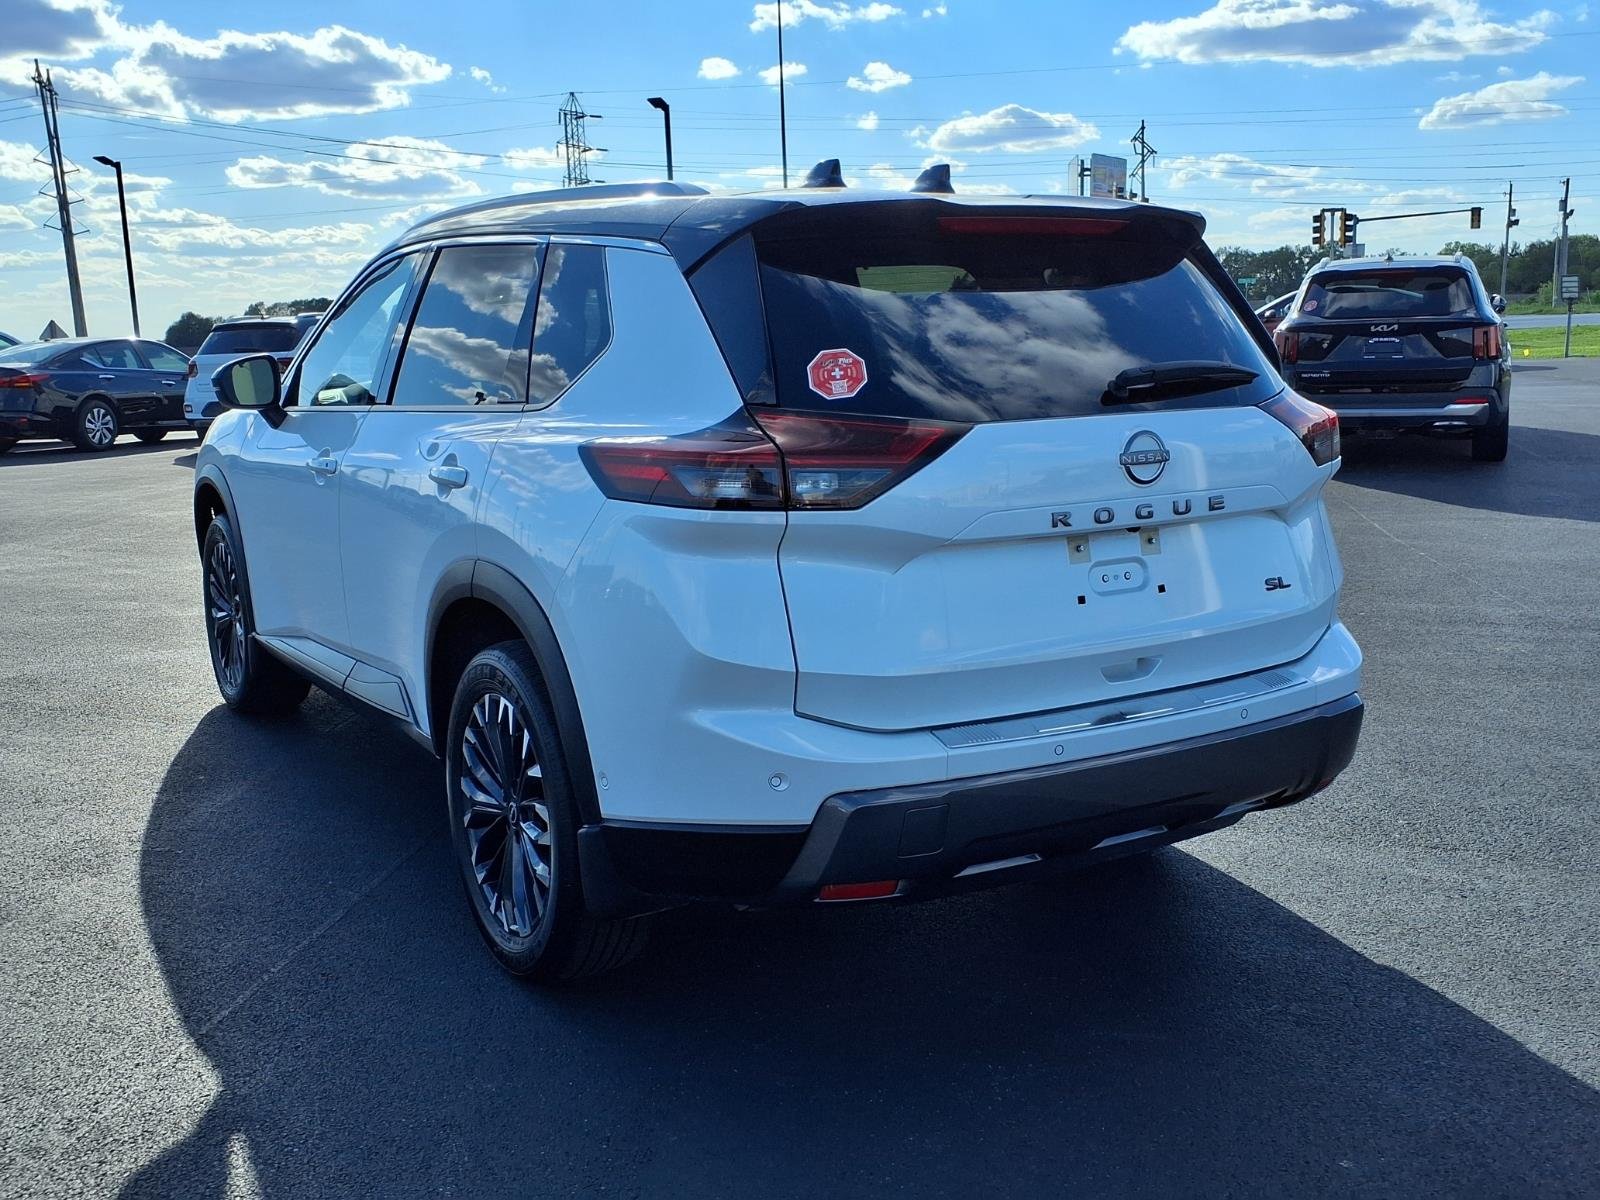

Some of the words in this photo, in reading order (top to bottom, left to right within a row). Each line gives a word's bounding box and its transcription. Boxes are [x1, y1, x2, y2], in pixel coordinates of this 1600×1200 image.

[1121, 452, 1169, 465] NISSAN
[1051, 495, 1226, 528] ROGUE
[1264, 576, 1292, 591] SL
